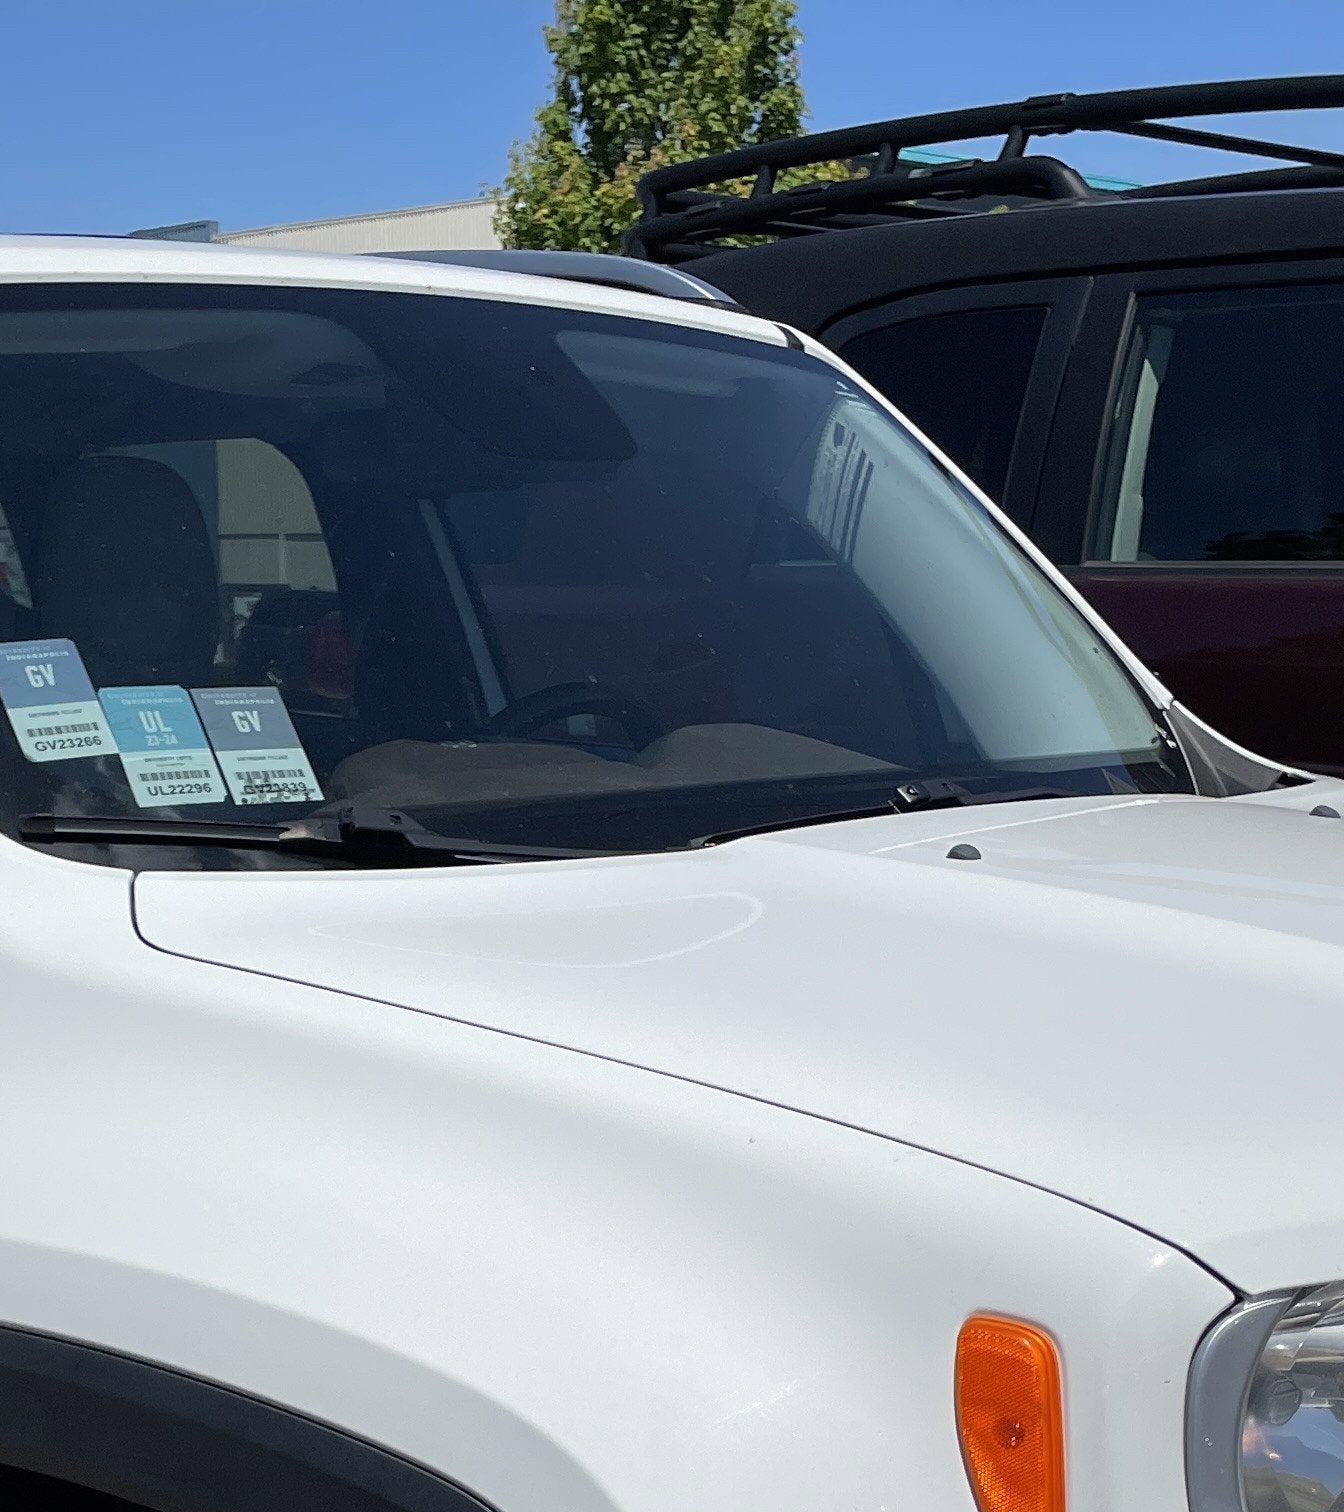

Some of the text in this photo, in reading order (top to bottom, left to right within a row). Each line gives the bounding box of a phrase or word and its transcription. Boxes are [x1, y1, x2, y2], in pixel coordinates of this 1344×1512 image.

[24, 663, 56, 688] GV
[138, 710, 173, 733] UL
[231, 710, 261, 733] GV
[147, 783, 212, 796] UL22296
